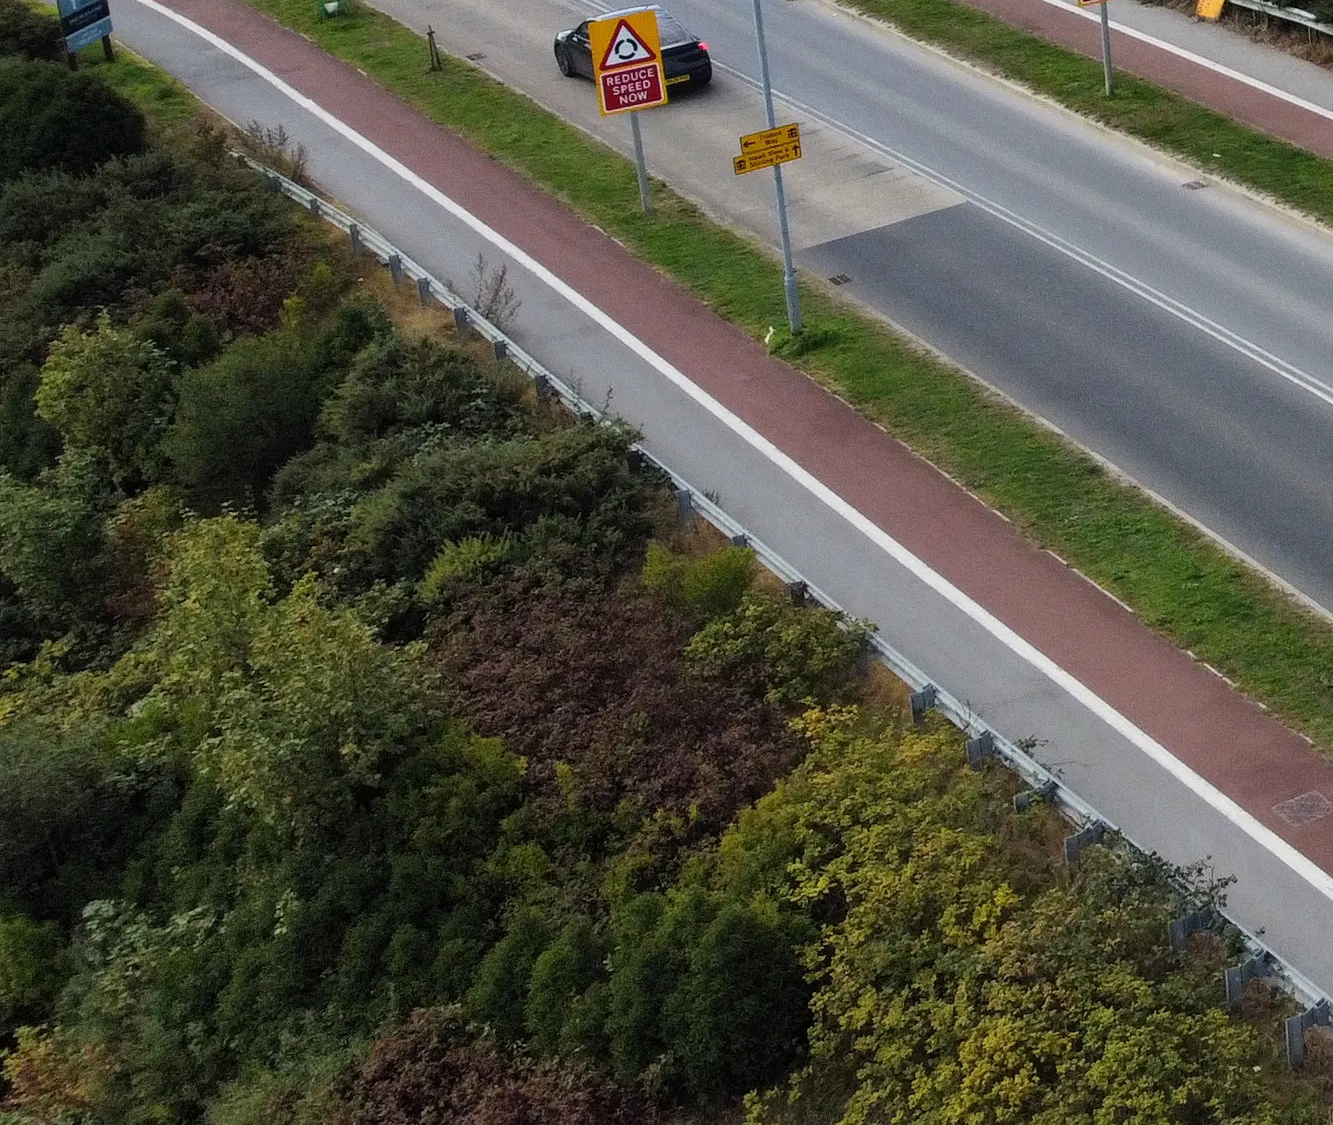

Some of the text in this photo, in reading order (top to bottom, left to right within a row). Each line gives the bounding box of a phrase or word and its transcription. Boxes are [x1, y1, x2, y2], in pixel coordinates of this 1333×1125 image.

[606, 68, 655, 86] REDUCE
[612, 80, 651, 95] SPEED
[619, 90, 648, 105] NOW
